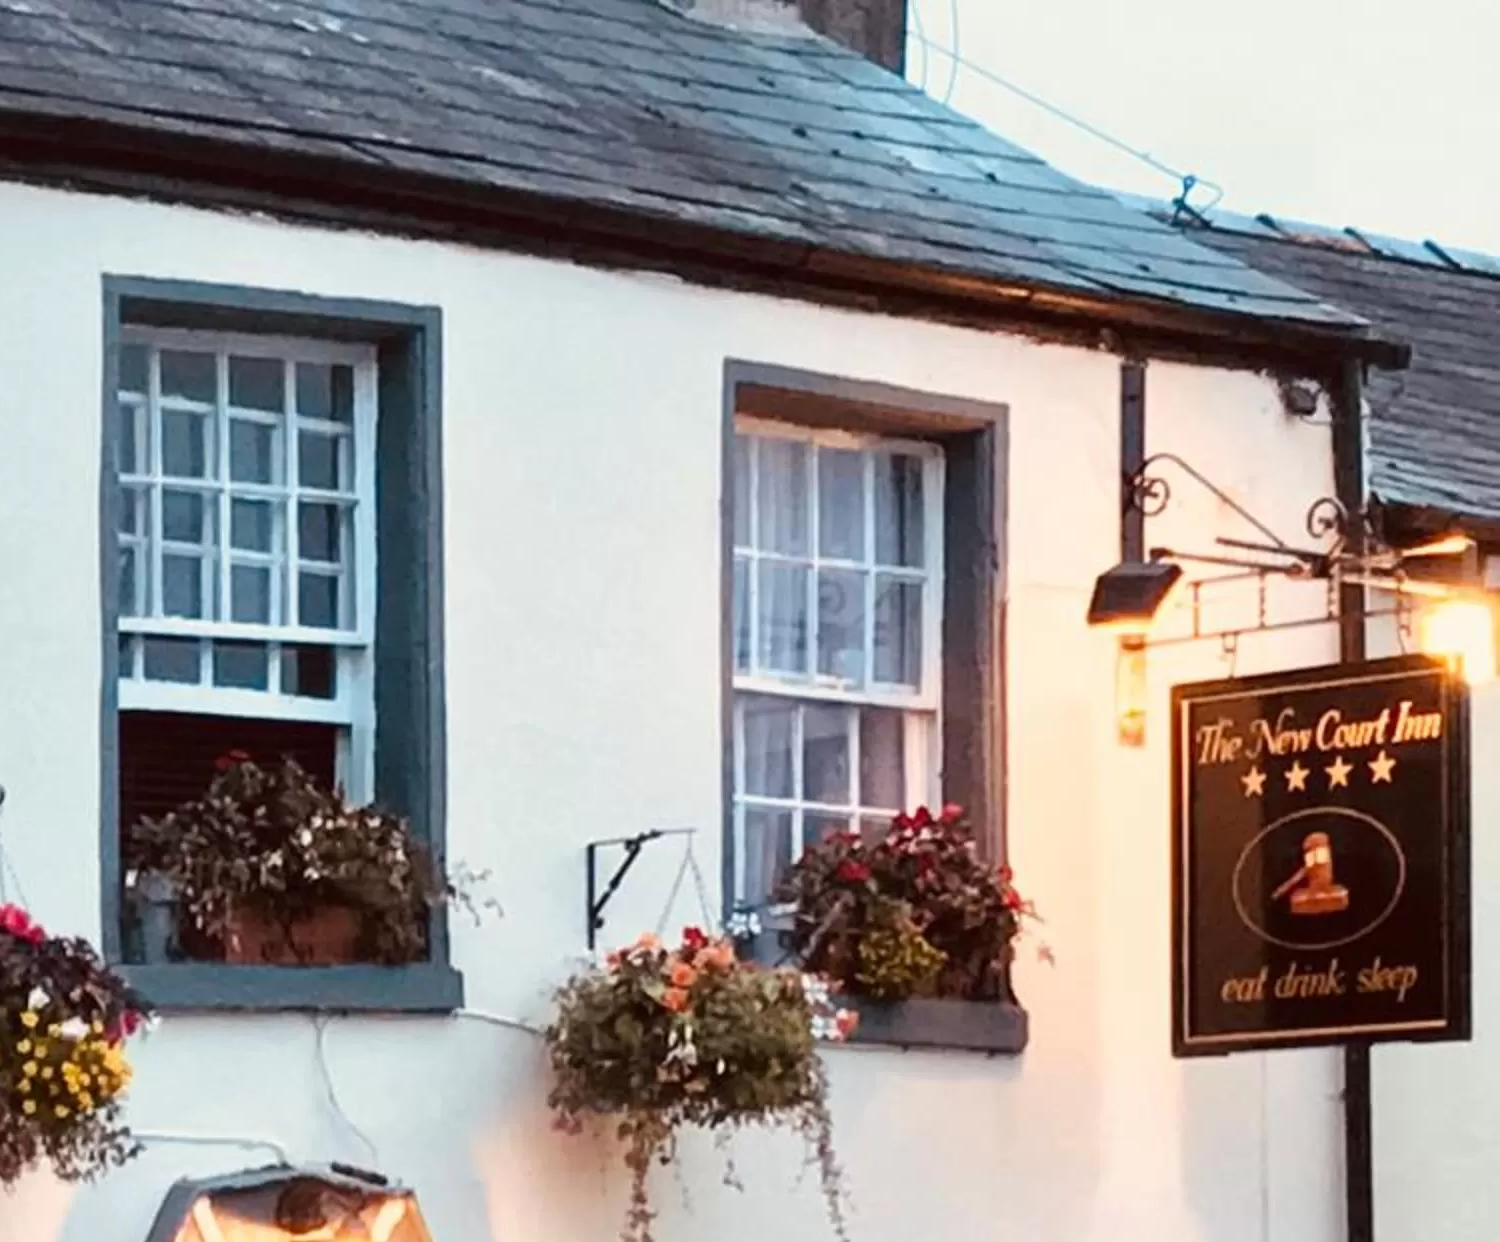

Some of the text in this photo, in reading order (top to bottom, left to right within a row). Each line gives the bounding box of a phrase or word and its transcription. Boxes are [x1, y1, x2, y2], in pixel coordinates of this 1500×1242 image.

[1197, 701, 1442, 765] The New Court Inn
[1221, 956, 1418, 1003] eat drink sleep
